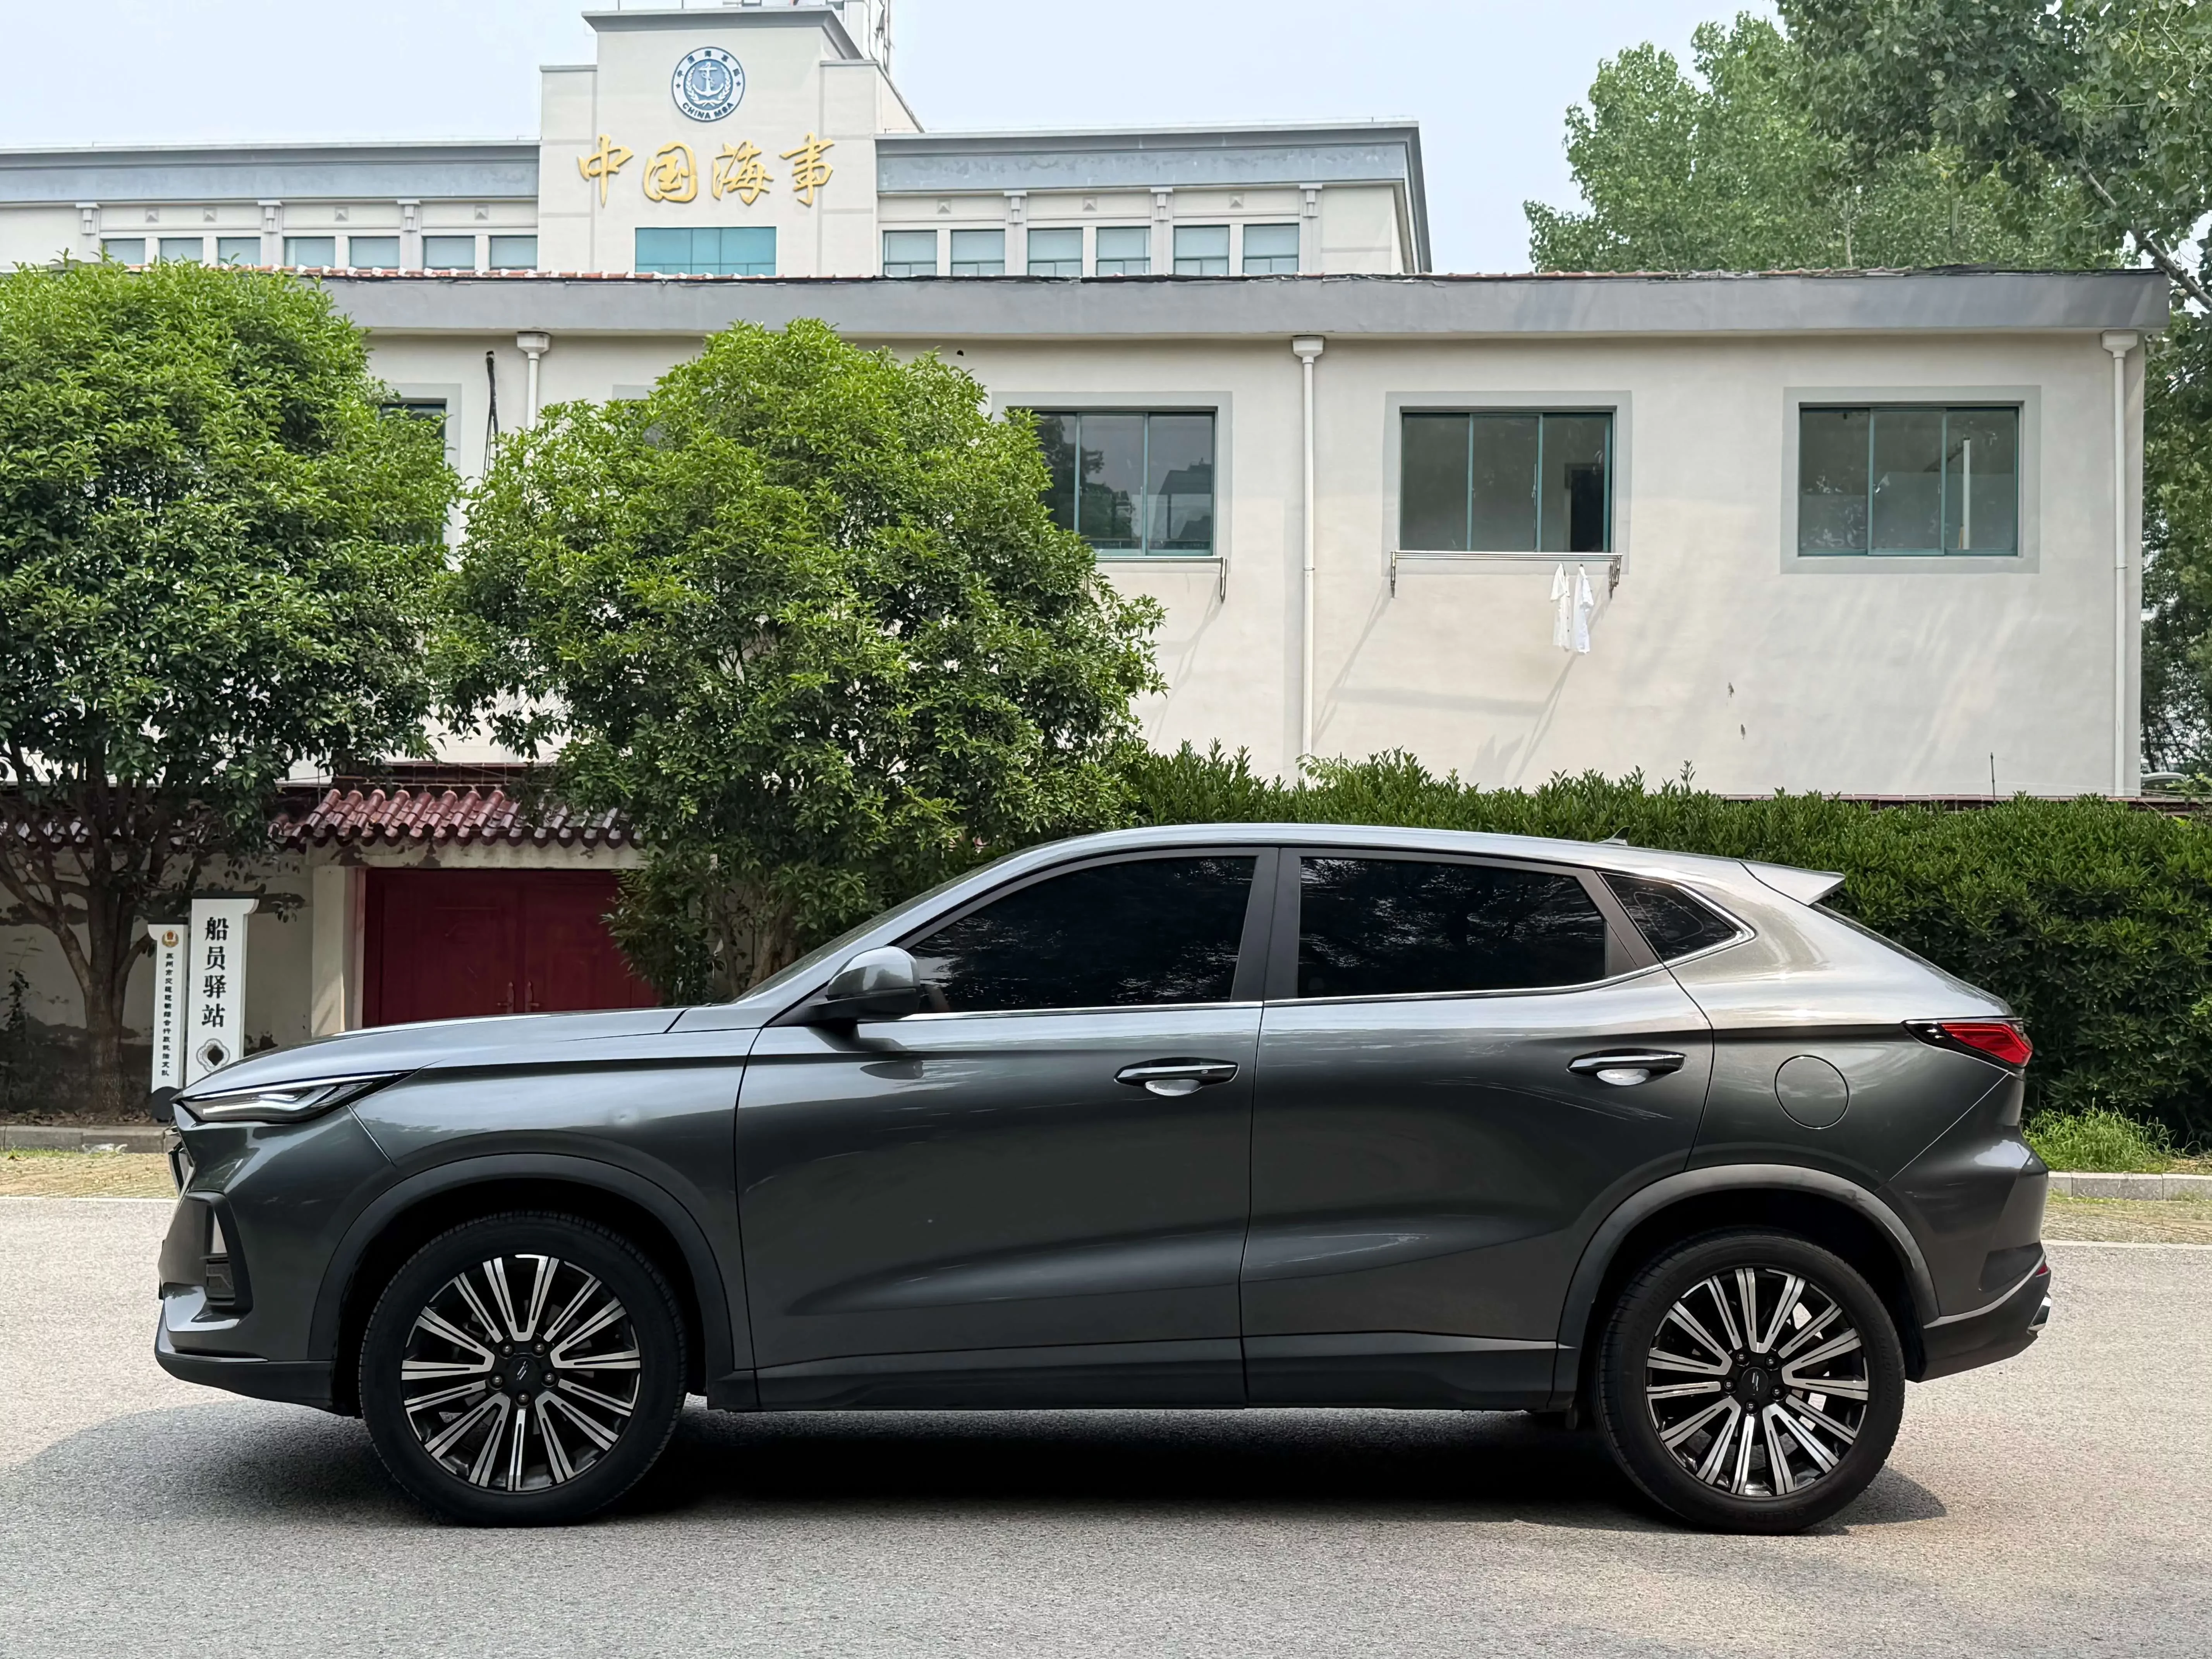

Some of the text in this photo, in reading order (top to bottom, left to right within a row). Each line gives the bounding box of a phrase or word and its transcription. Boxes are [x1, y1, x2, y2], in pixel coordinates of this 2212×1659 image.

[682, 102, 711, 119] CHINA
[577, 132, 835, 208] 中国海事
[201, 916, 229, 1028] 船员驿站
